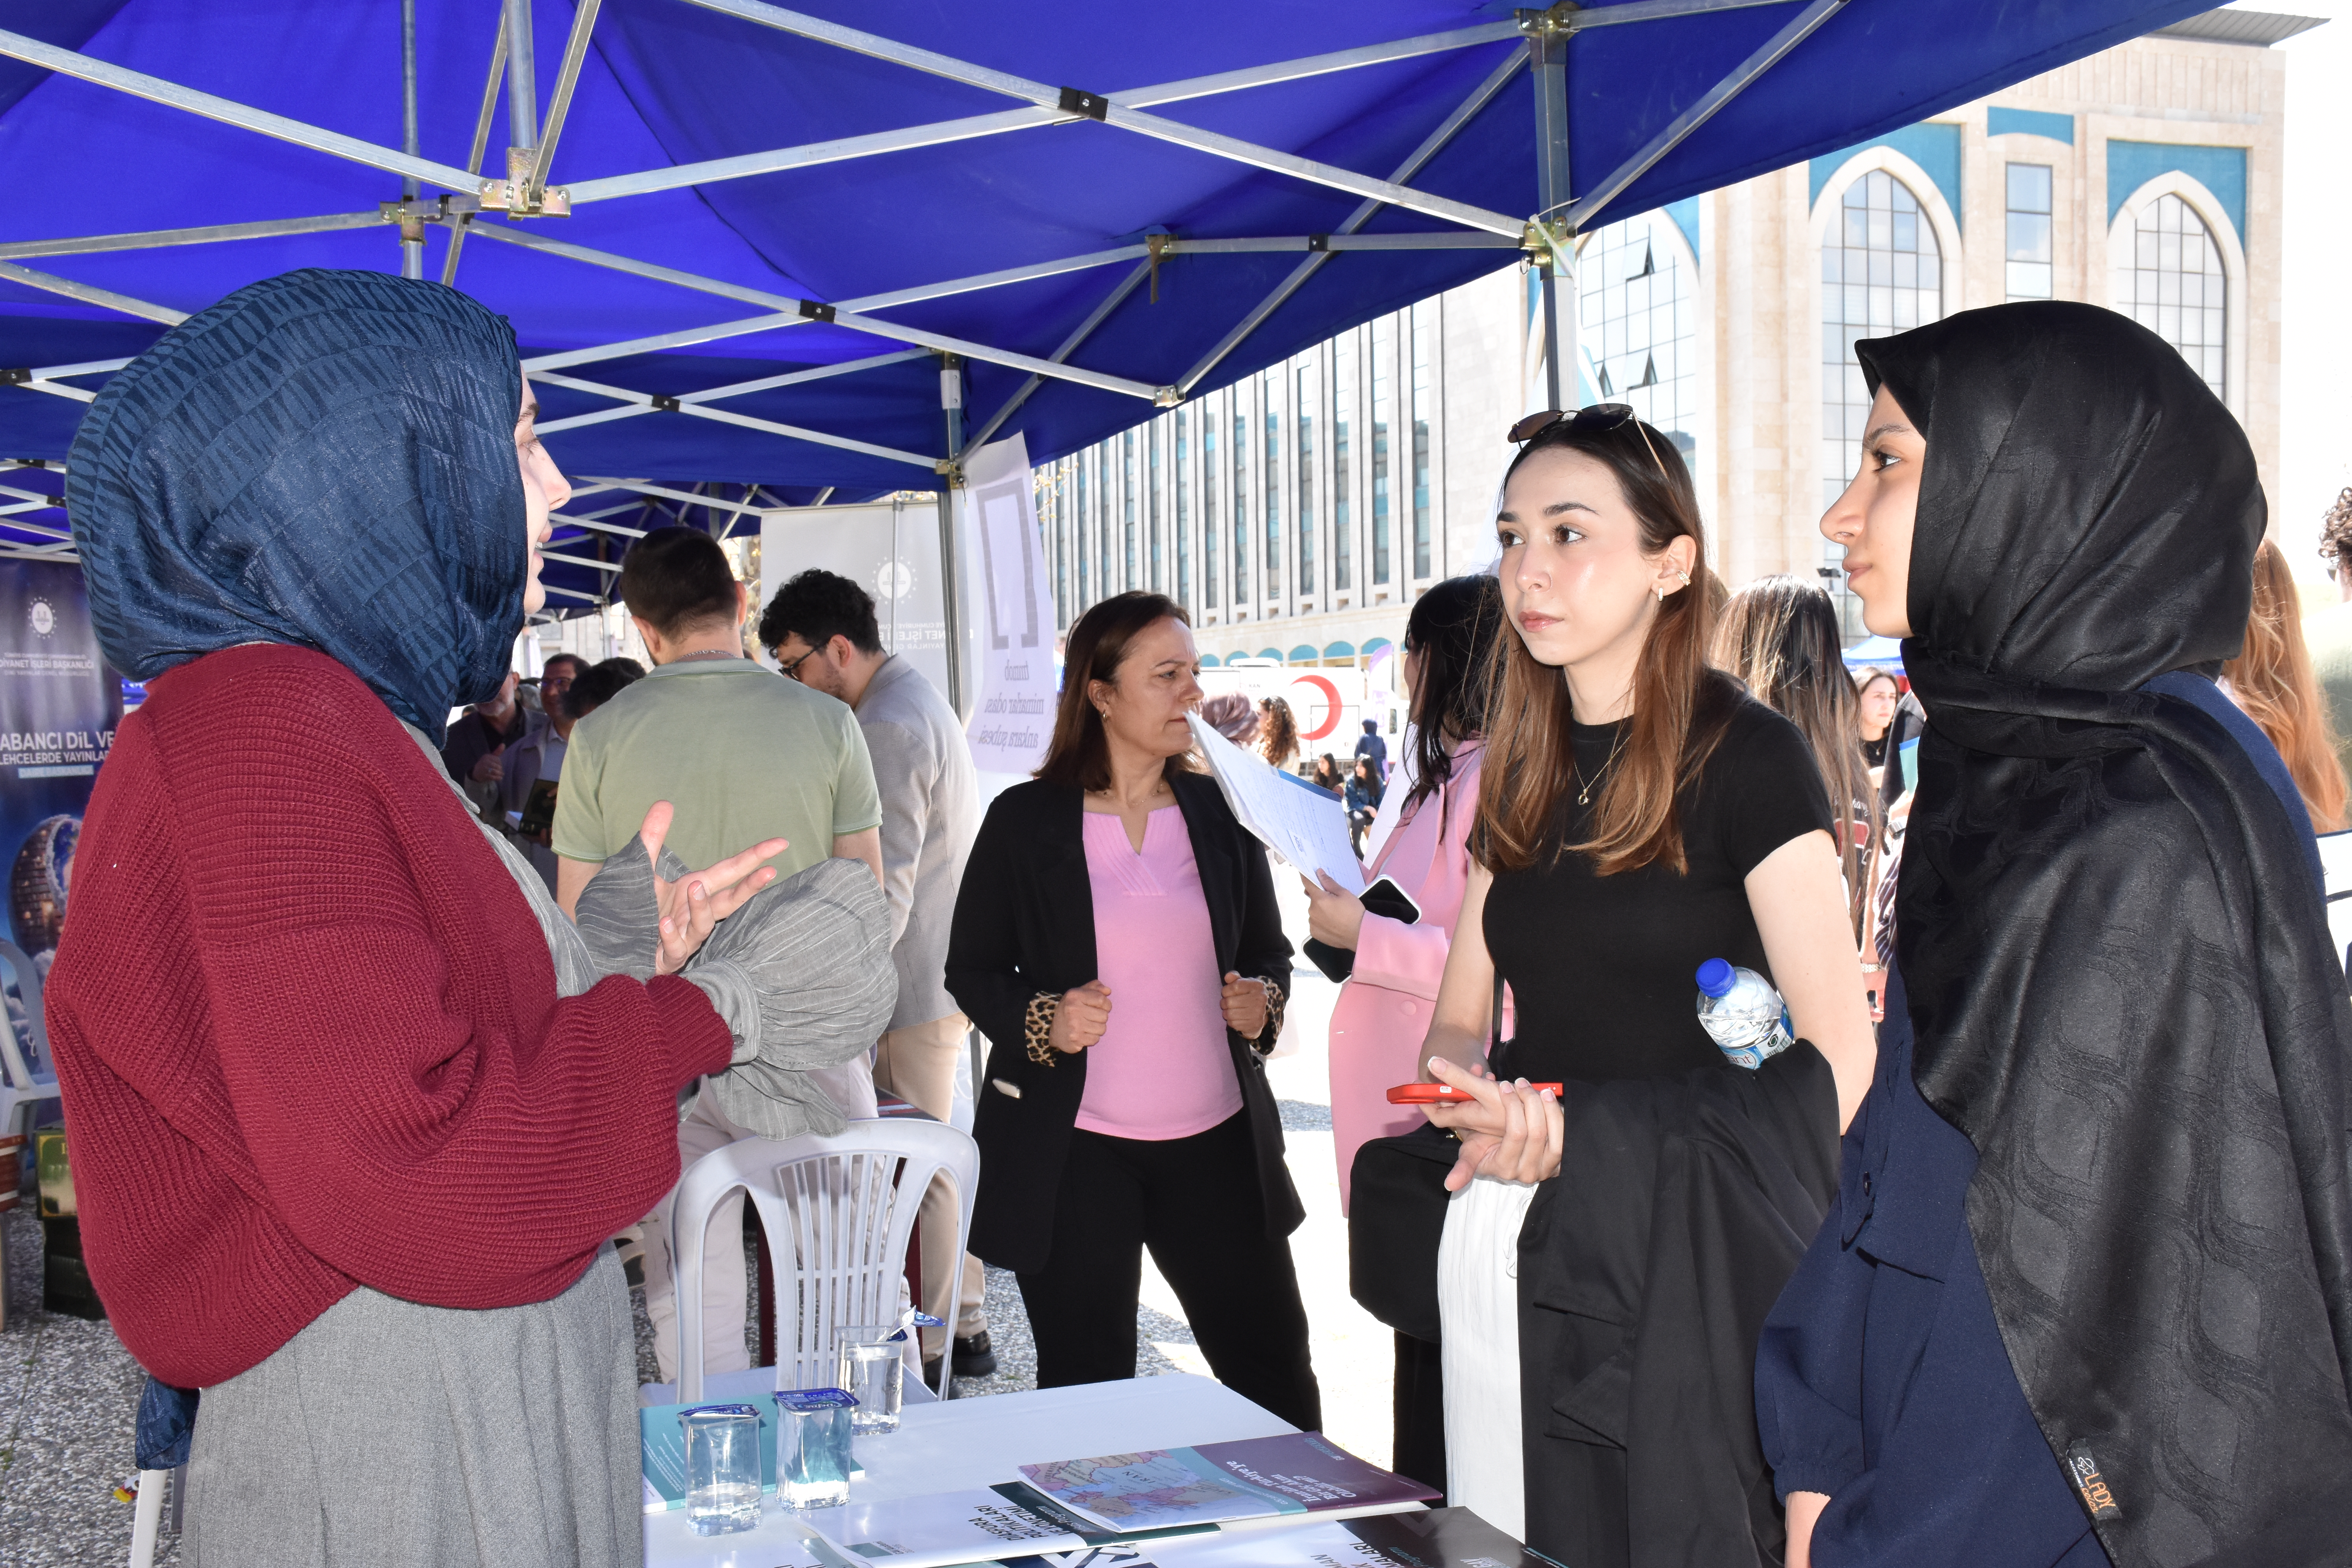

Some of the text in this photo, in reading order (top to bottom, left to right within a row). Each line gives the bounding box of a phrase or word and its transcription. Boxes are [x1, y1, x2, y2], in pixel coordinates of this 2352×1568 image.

[1122, 1471, 1156, 1484] IRAN
[1226, 1461, 1321, 1502] İran'dan Türkiye'ye
[1270, 1474, 1302, 1486] Akını
[1292, 1475, 1357, 1497] Olabilir mi?
[1317, 1491, 1340, 1500] Bir
[2081, 1488, 2099, 1514] color
[2085, 1473, 2116, 1508] LADY
[974, 1505, 1049, 1538] POLİTİKALARI
[998, 1505, 1057, 1531] YÖNETİMİ
[1036, 1505, 1073, 1524] Programı
[968, 1517, 1026, 1541] DİASPORA
